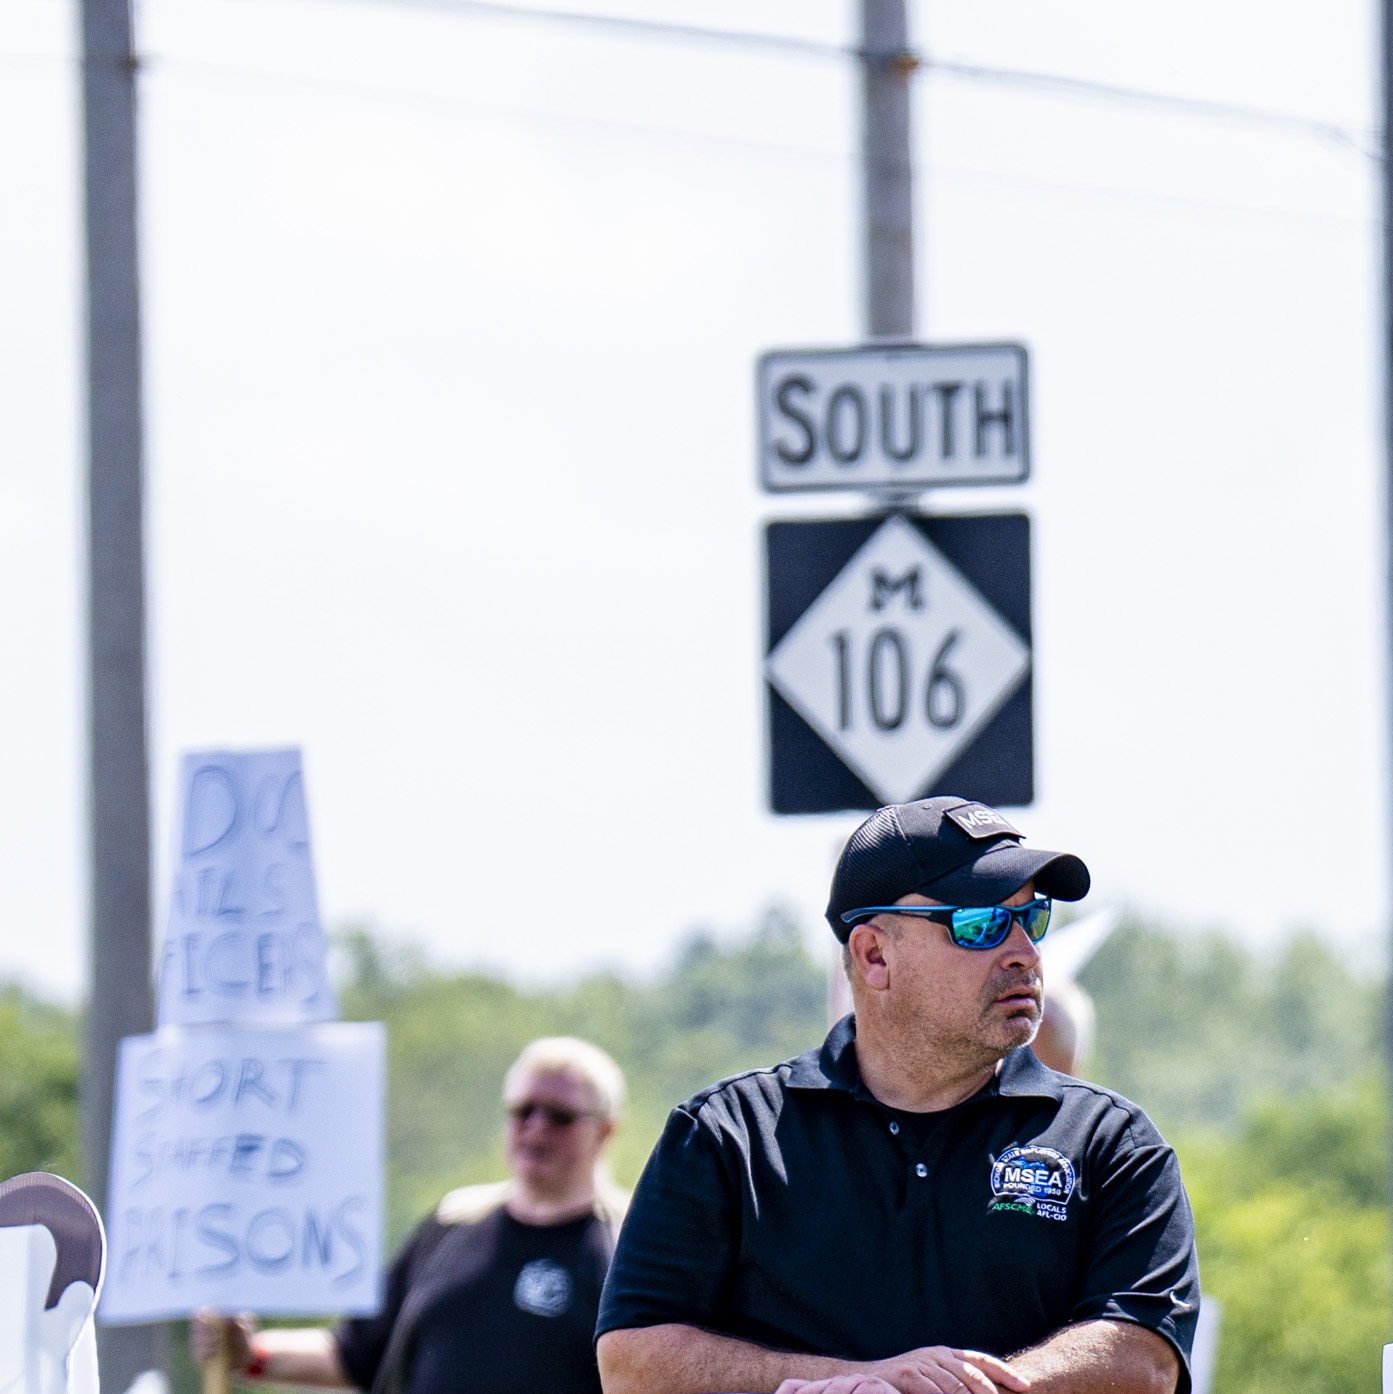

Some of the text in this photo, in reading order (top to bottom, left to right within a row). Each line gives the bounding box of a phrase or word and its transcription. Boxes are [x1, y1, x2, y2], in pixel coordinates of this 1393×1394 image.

[774, 373, 1018, 467] SOUTH
[869, 561, 924, 611] M
[830, 625, 964, 732] 106
[1004, 1167, 1063, 1188] MSEA
[1003, 1182, 1062, 1196] FOUNDED 1950
[1036, 1202, 1067, 1214] LOCALS
[1036, 1210, 1067, 1221] AFL-CIO
